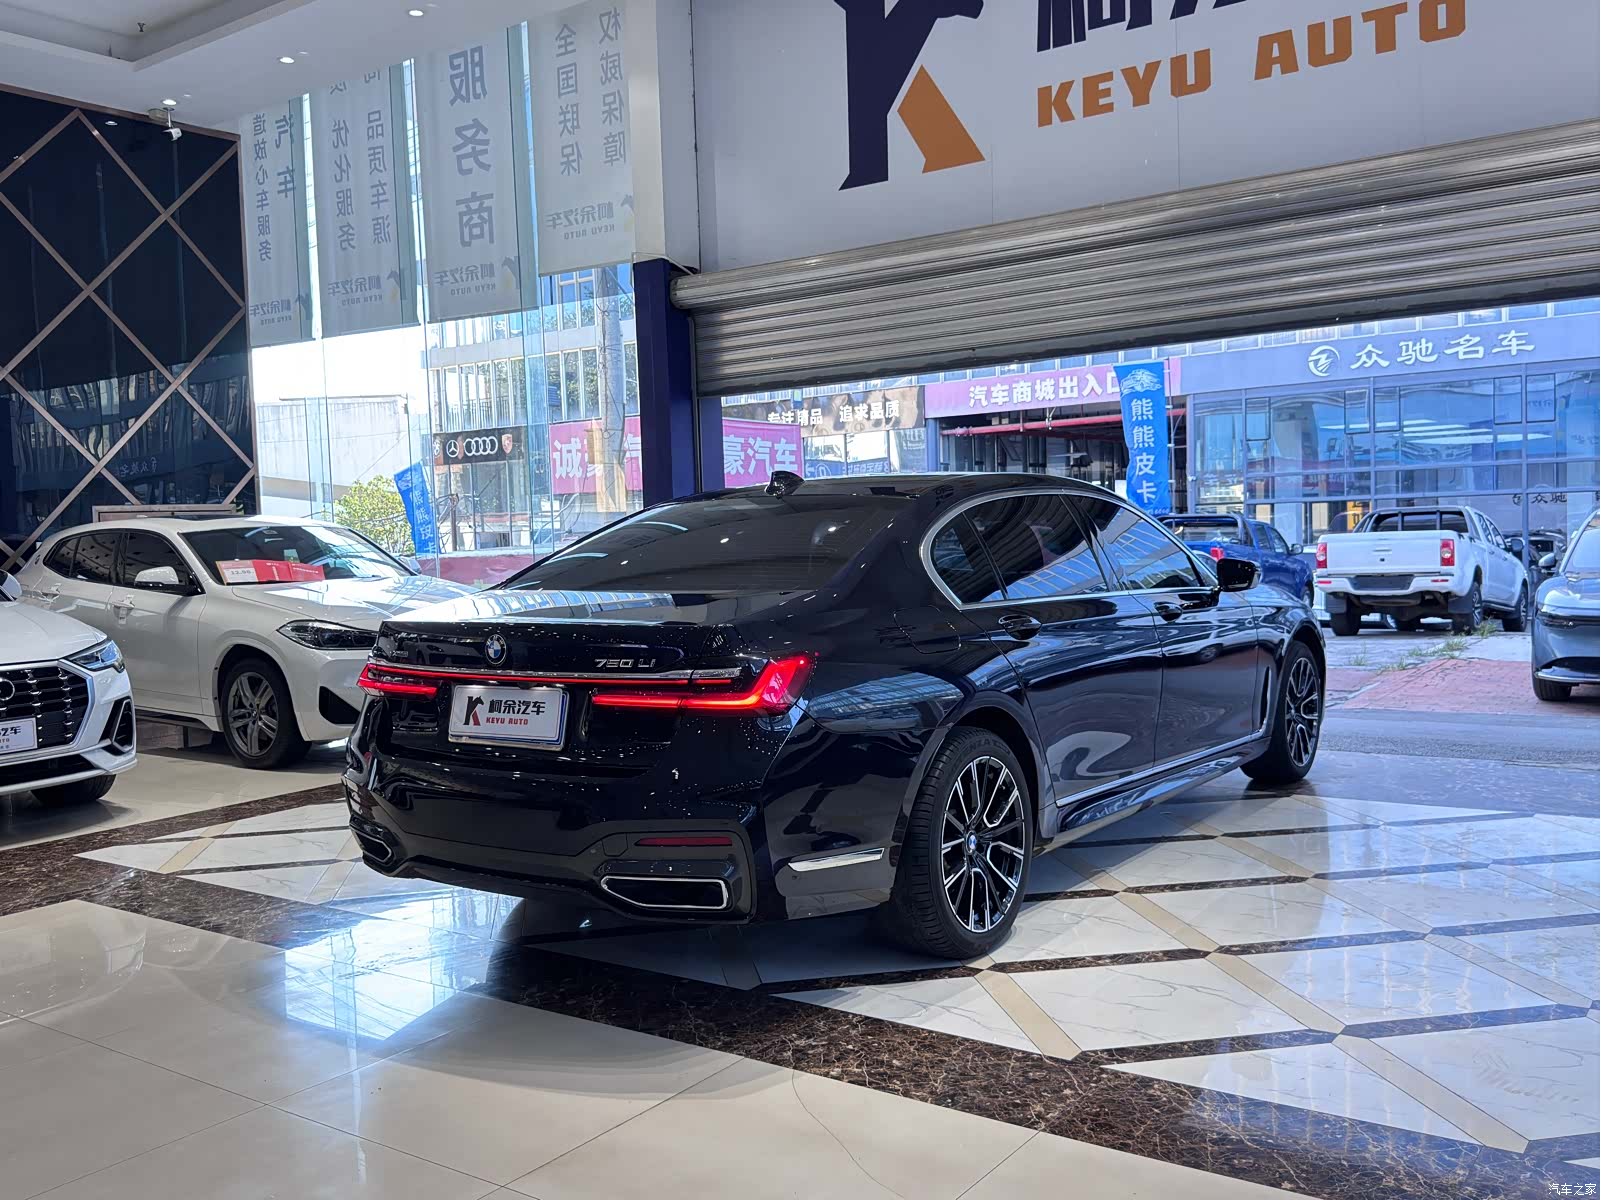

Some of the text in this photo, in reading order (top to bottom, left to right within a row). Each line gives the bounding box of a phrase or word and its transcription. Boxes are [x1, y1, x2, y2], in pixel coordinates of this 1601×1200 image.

[1038, 48, 1211, 128] KEYU
[1254, 0, 1466, 80] AUTO
[1350, 330, 1535, 370] 众驰名车
[839, 400, 900, 422] 追求品质
[1131, 398, 1157, 503] 熊熊皮卡
[594, 658, 634, 668] 750
[488, 699, 546, 716] 柯余汽车
[486, 716, 529, 726] KEYU AUTO
